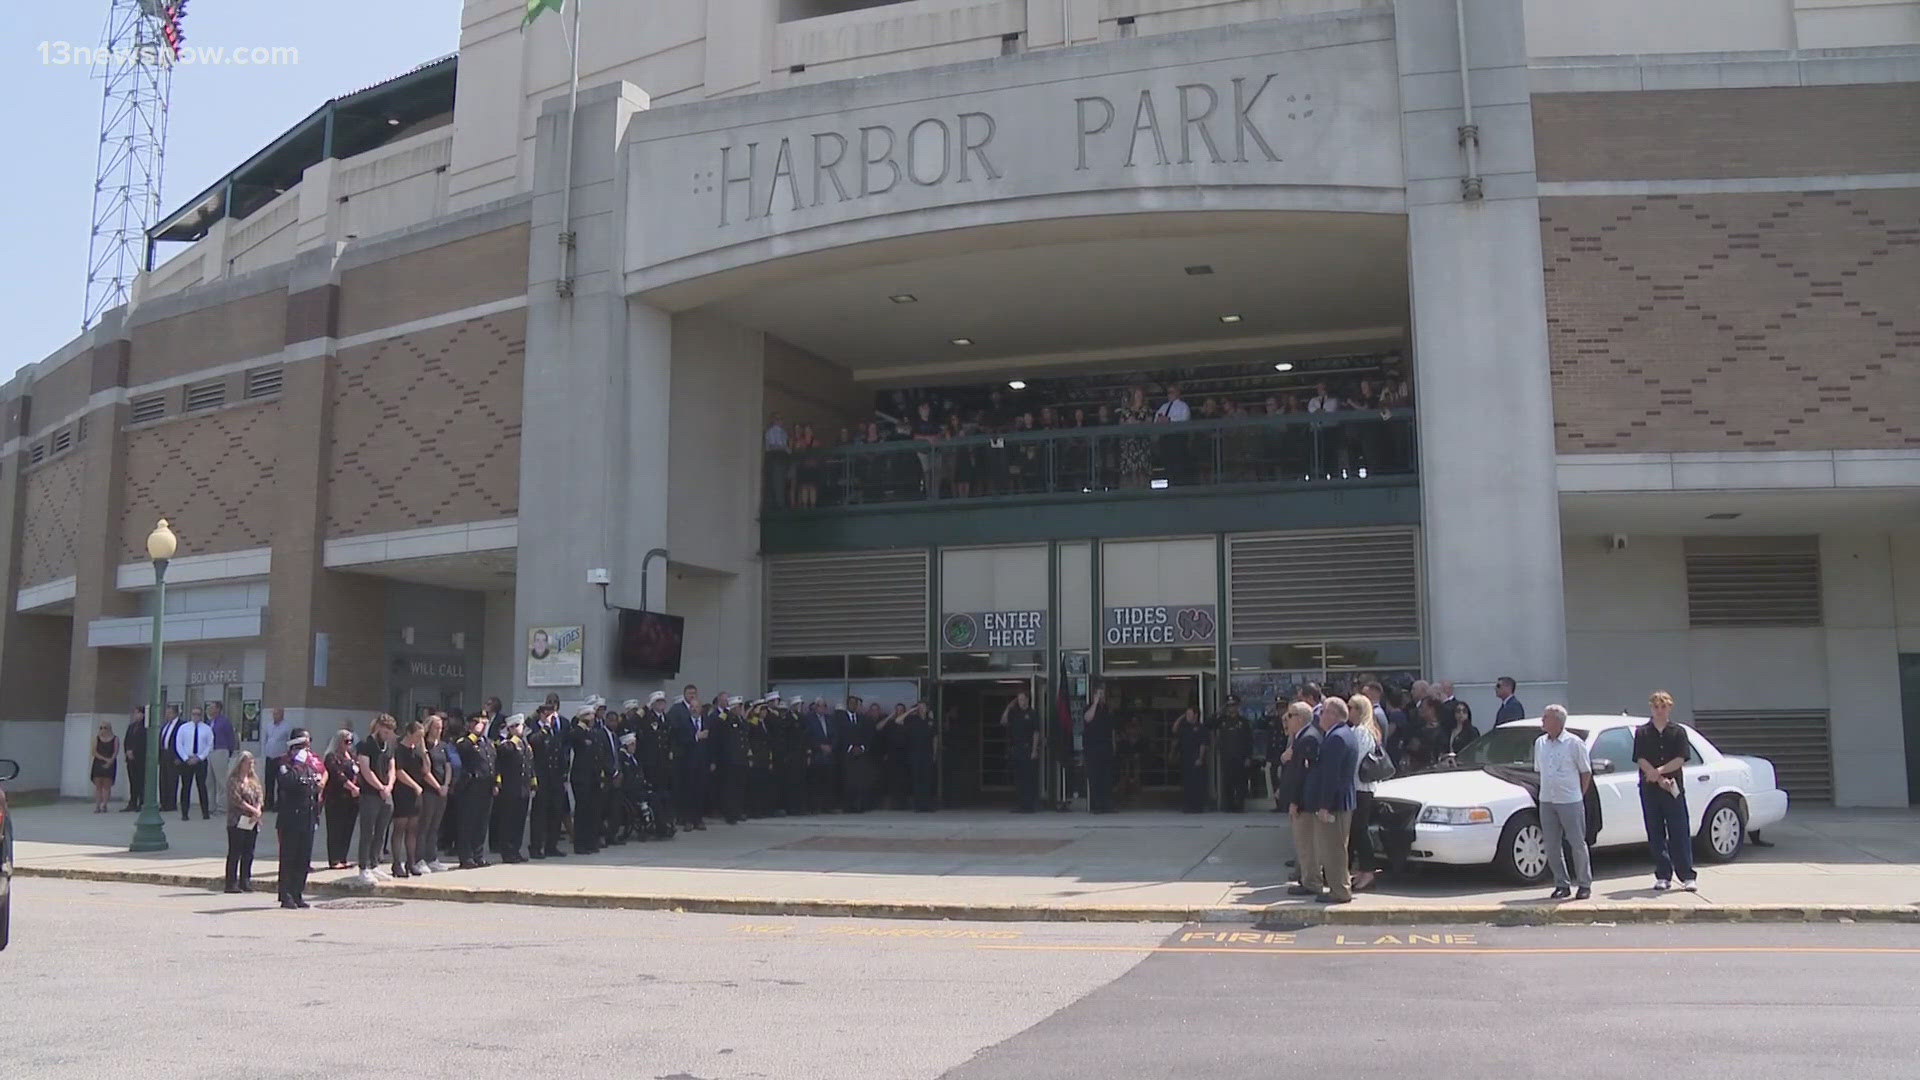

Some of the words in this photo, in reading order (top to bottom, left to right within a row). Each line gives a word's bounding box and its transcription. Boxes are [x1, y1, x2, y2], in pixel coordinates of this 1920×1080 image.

[718, 111, 1003, 228] HARBOR
[1073, 73, 1284, 171] PARK
[983, 612, 1042, 630] ENTER
[1113, 607, 1168, 626] TIDES
[988, 629, 1036, 647] HERE
[1106, 626, 1175, 645] OFFICE
[191, 671, 208, 684] BOX
[209, 669, 238, 682] OFFICE
[410, 661, 436, 675] WILL
[439, 663, 465, 677] CALL
[1180, 932, 1297, 944] FIRE
[1336, 934, 1478, 945] LANE
